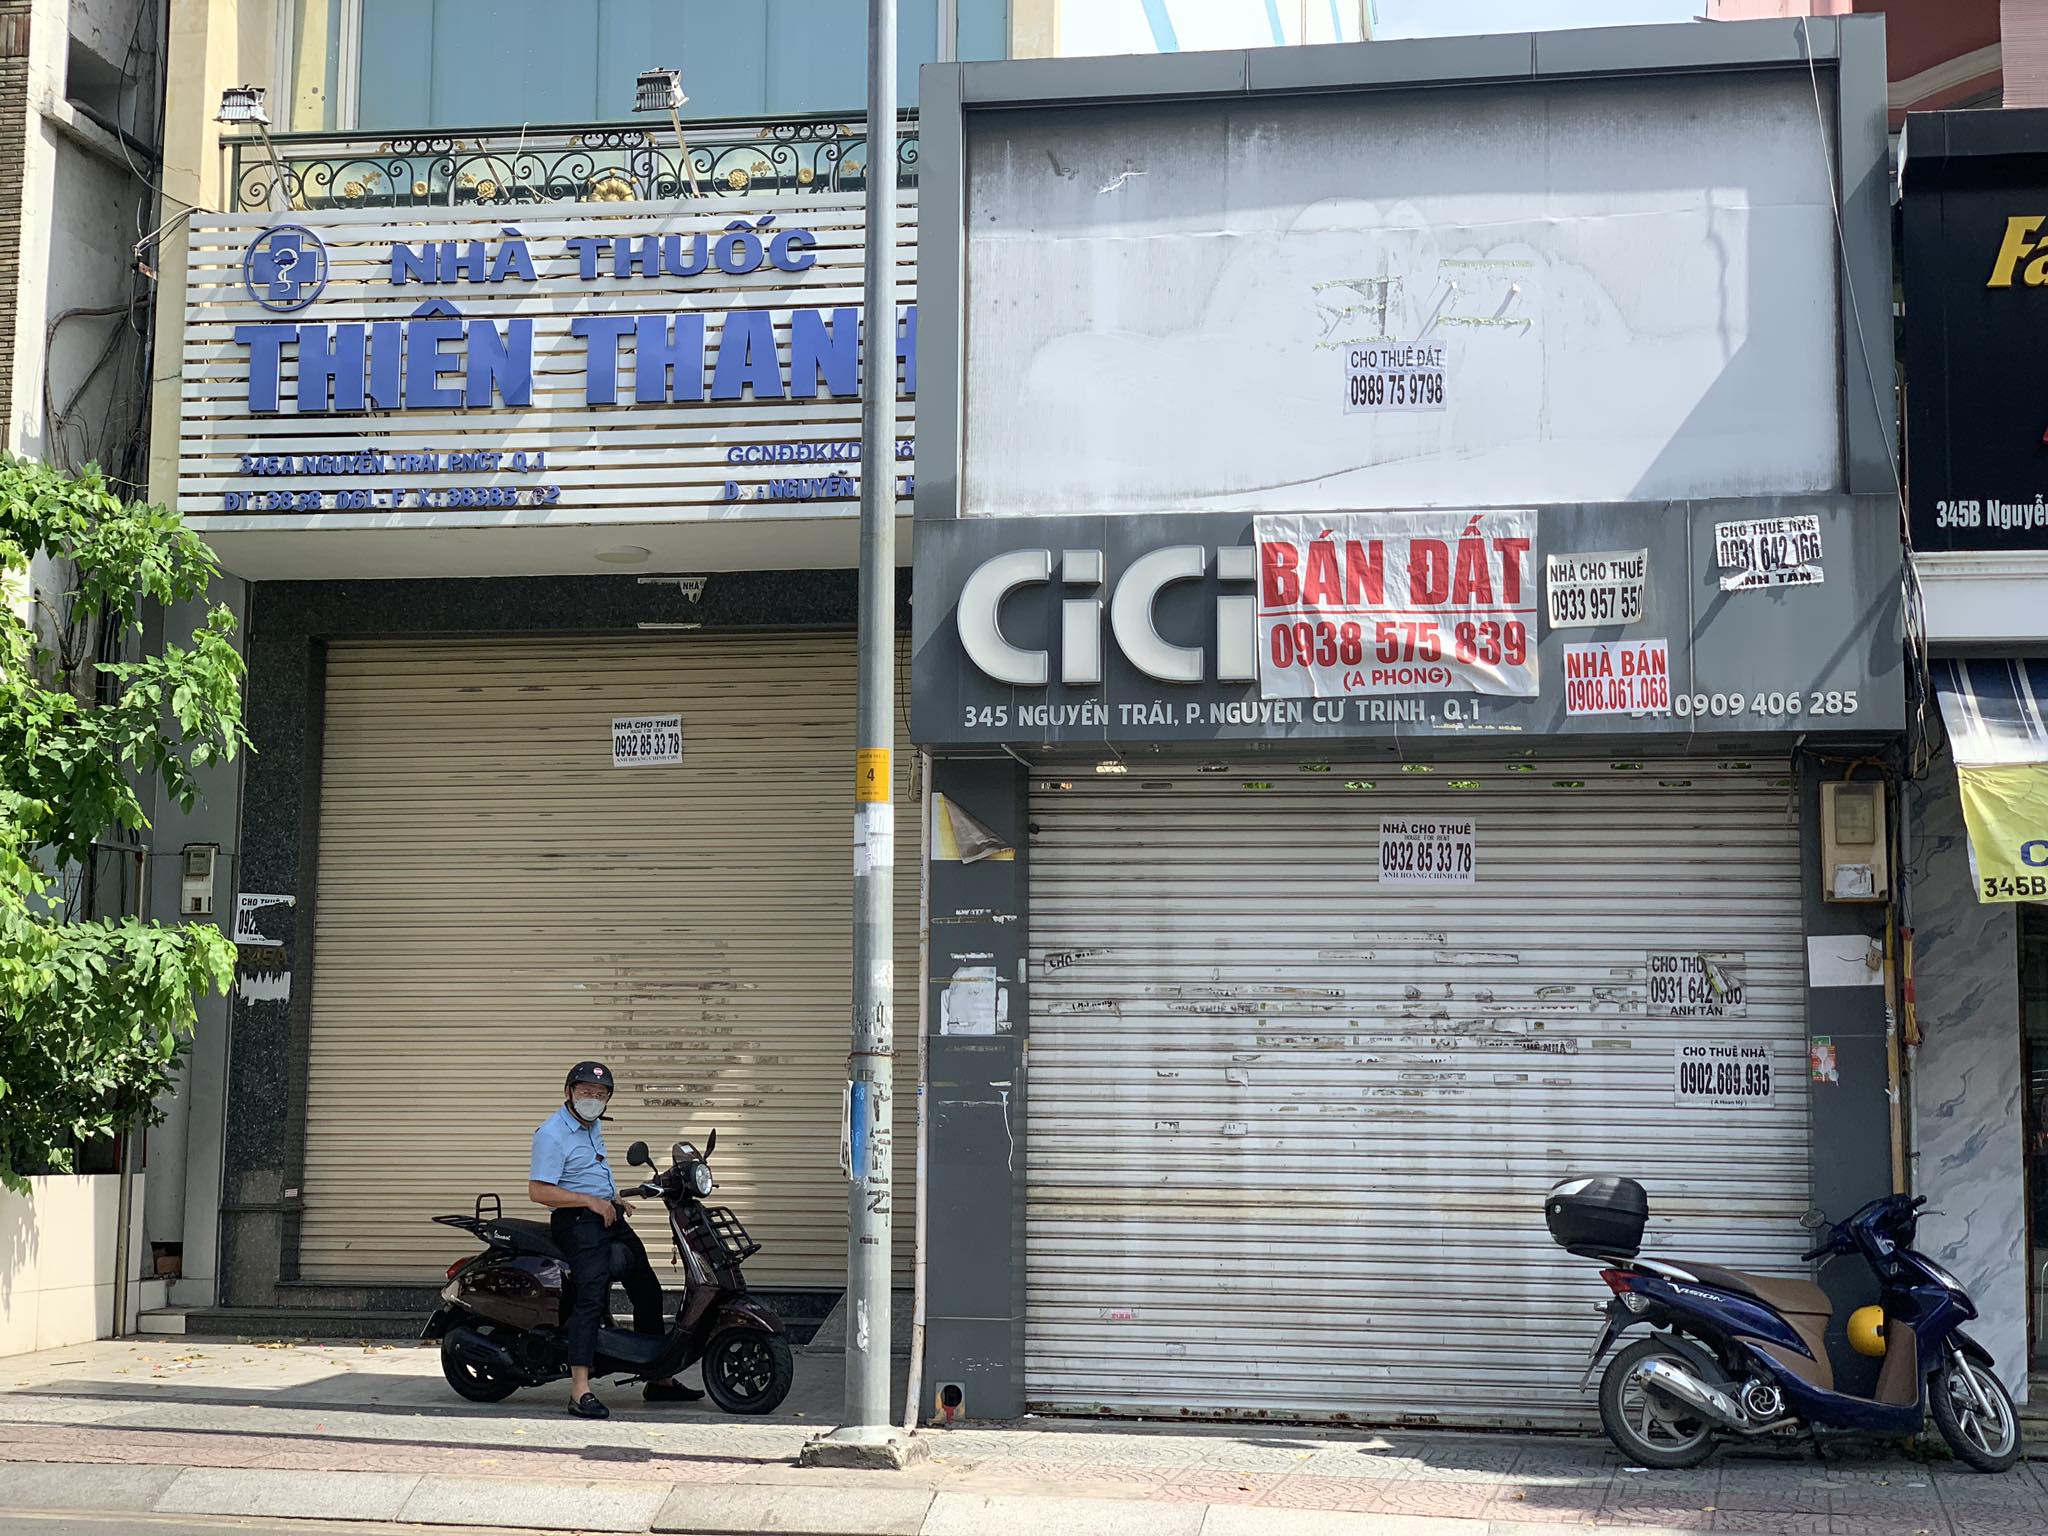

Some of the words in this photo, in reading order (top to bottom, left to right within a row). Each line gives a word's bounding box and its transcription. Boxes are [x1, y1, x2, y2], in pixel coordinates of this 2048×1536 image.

[391, 227, 538, 285] NHÀ
[566, 215, 817, 281] THUỐC
[234, 298, 534, 413] THIÊN
[1350, 350, 1378, 369] CHO
[1381, 345, 1414, 368] THUÊ
[1350, 374, 1384, 406] 0989
[1388, 374, 1405, 405] 75
[1409, 372, 1443, 405] 9798
[1936, 500, 1981, 528] 345B
[1986, 493, 2048, 531] Nguyễ
[1720, 525, 1747, 538] CHO
[1261, 528, 1385, 608] BÁN
[1406, 514, 1531, 605] ĐẤT
[1720, 538, 1757, 571] 0931
[1760, 535, 1788, 572] 642
[1791, 532, 1820, 564] 166
[1550, 559, 1577, 582] NHÀ
[1579, 562, 1607, 581] CHO
[1610, 555, 1644, 579] THUÊ
[1551, 588, 1587, 621] 0933
[1590, 587, 1616, 620] 957
[1270, 620, 1362, 669] 0938
[1374, 621, 1443, 664] 575
[1454, 620, 1527, 666] 839
[1567, 644, 1613, 679] NHÀ
[1620, 642, 1667, 677] BÁN
[1343, 671, 1366, 693] (A
[1371, 667, 1453, 690] PHONG)
[1567, 676, 1668, 712] 0908.061.068
[964, 705, 1008, 728] 345
[1018, 698, 1109, 727] NGUYỄN
[1118, 699, 1179, 727] TRÃI,
[1186, 702, 1205, 725] P.
[1443, 698, 1480, 721] Q.1
[1674, 692, 1746, 718] 0909
[1750, 691, 1802, 716] 406
[1808, 690, 1859, 715] 285
[614, 720, 633, 730] NHÀ
[634, 721, 653, 729] CHO
[655, 719, 679, 728] THUÊ
[615, 734, 638, 758] 0932
[640, 733, 652, 756] 85
[654, 733, 666, 755] 33
[668, 732, 680, 755] 78
[866, 767, 876, 782] 4
[1382, 822, 1408, 834] NHÀ
[1411, 824, 1436, 834] CHO
[1439, 822, 1471, 835] THUÊ
[1382, 841, 1414, 871] 0932
[1417, 842, 1433, 871] 85
[1436, 842, 1452, 872] 33
[1456, 842, 1472, 873] 78
[1983, 876, 2047, 898] 345B
[241, 897, 258, 906] CHO
[1651, 955, 1678, 973] CHO
[1650, 975, 1683, 1004] 0931
[1687, 976, 1713, 1004] 642
[1670, 1006, 1696, 1016] ANH
[1682, 1046, 1707, 1057] CHO
[1709, 1045, 1739, 1057] THUÊ
[1741, 1045, 1766, 1058] NHÀ
